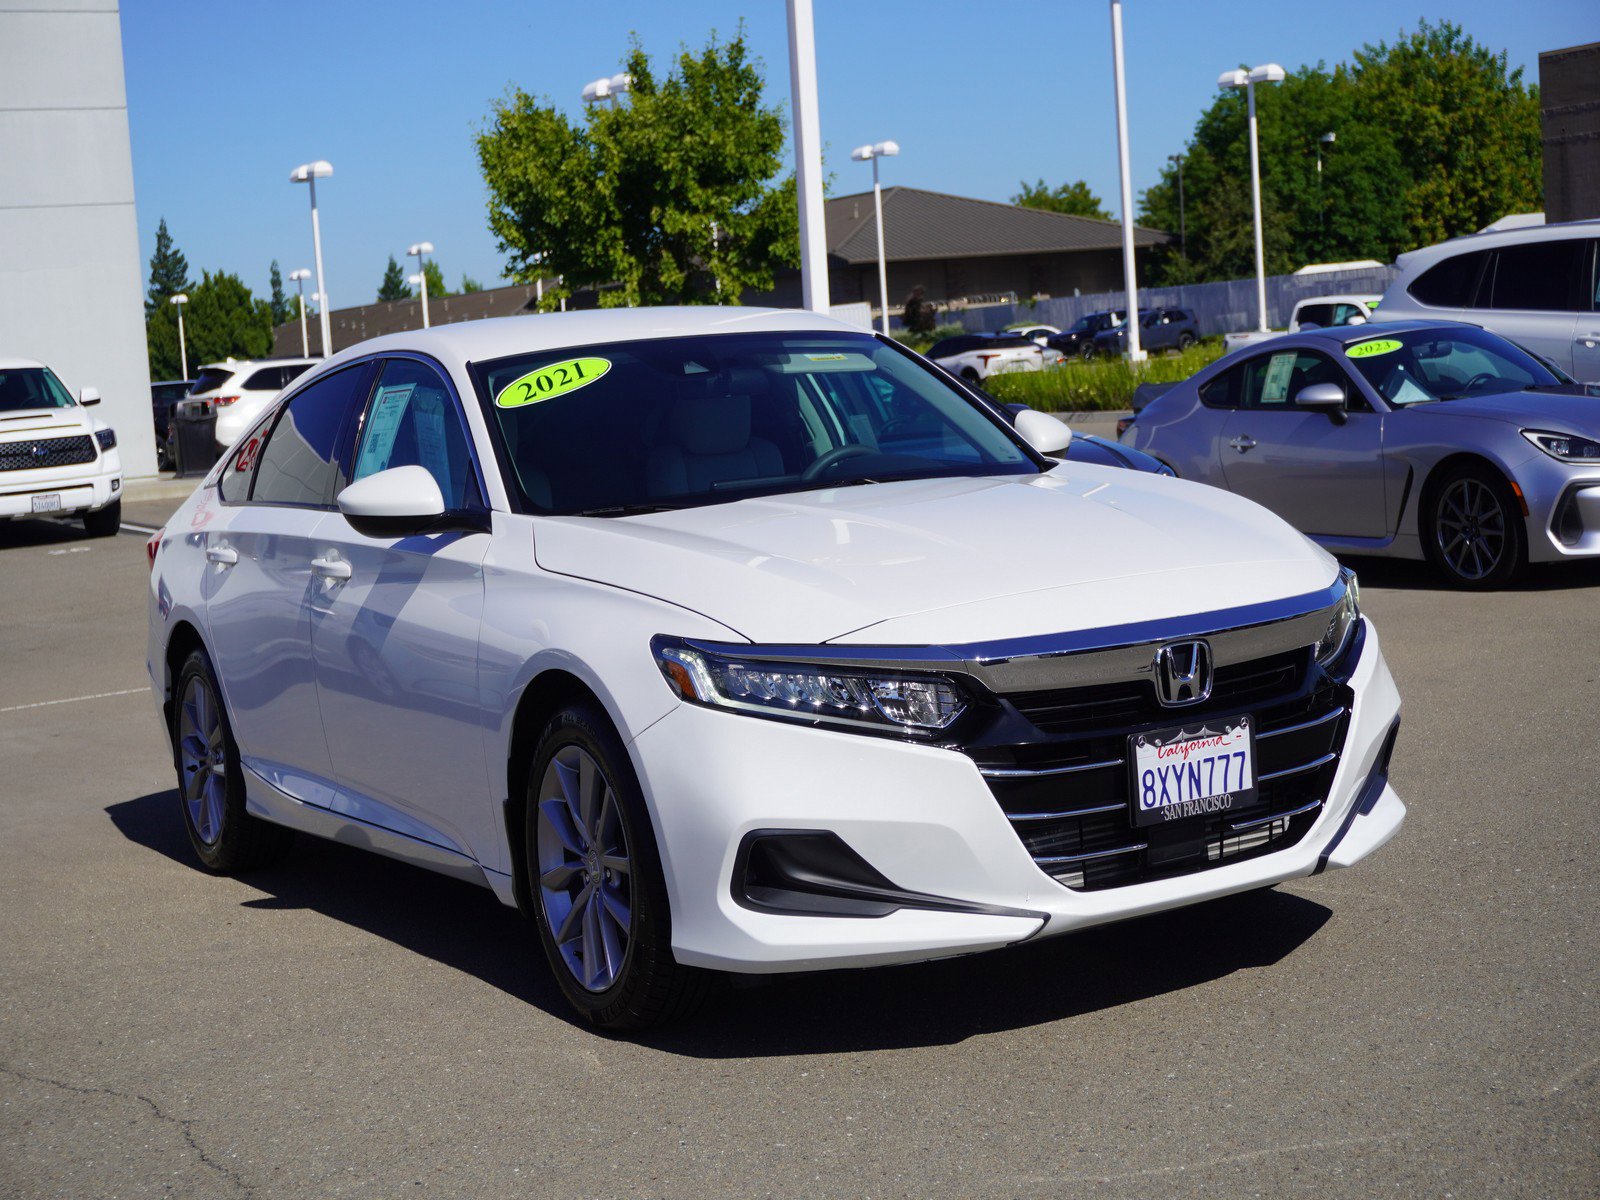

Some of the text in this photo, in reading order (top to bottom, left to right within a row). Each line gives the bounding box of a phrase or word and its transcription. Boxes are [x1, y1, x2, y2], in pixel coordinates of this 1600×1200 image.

[1357, 341, 1391, 356] 2023
[517, 362, 587, 401] 2021
[1157, 735, 1231, 760] California
[1142, 751, 1246, 808] 8XYN777
[1164, 793, 1232, 820] SAN FRANCISCO
